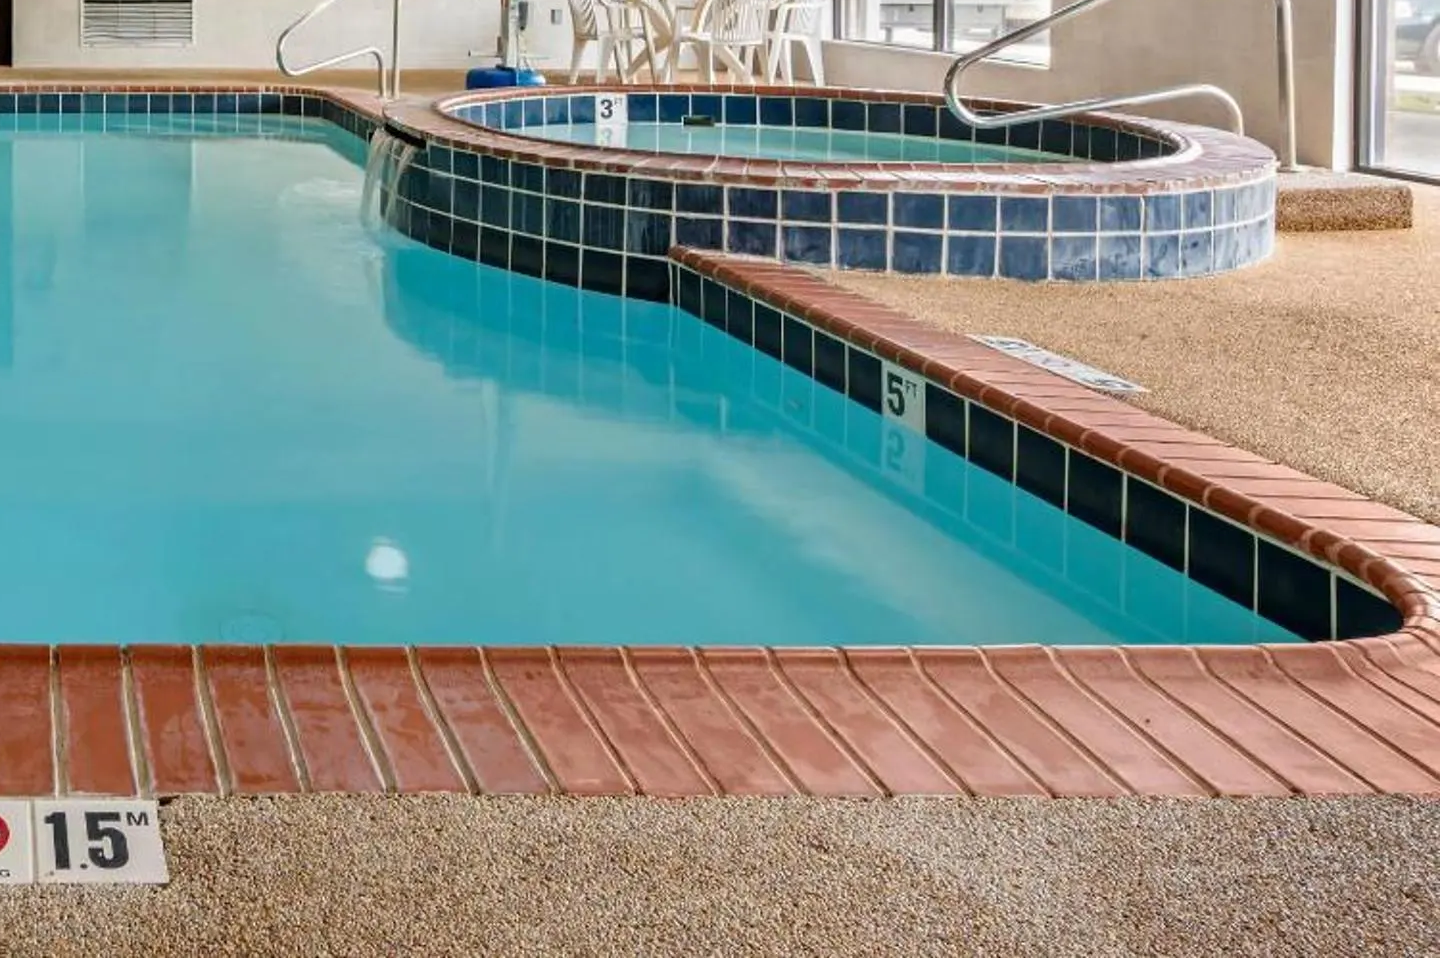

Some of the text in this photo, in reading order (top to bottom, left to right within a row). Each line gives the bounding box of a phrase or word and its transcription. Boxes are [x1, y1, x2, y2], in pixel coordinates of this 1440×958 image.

[600, 99, 613, 119] 3
[887, 371, 905, 417] 5
[44, 811, 149, 871] 1.5 M
